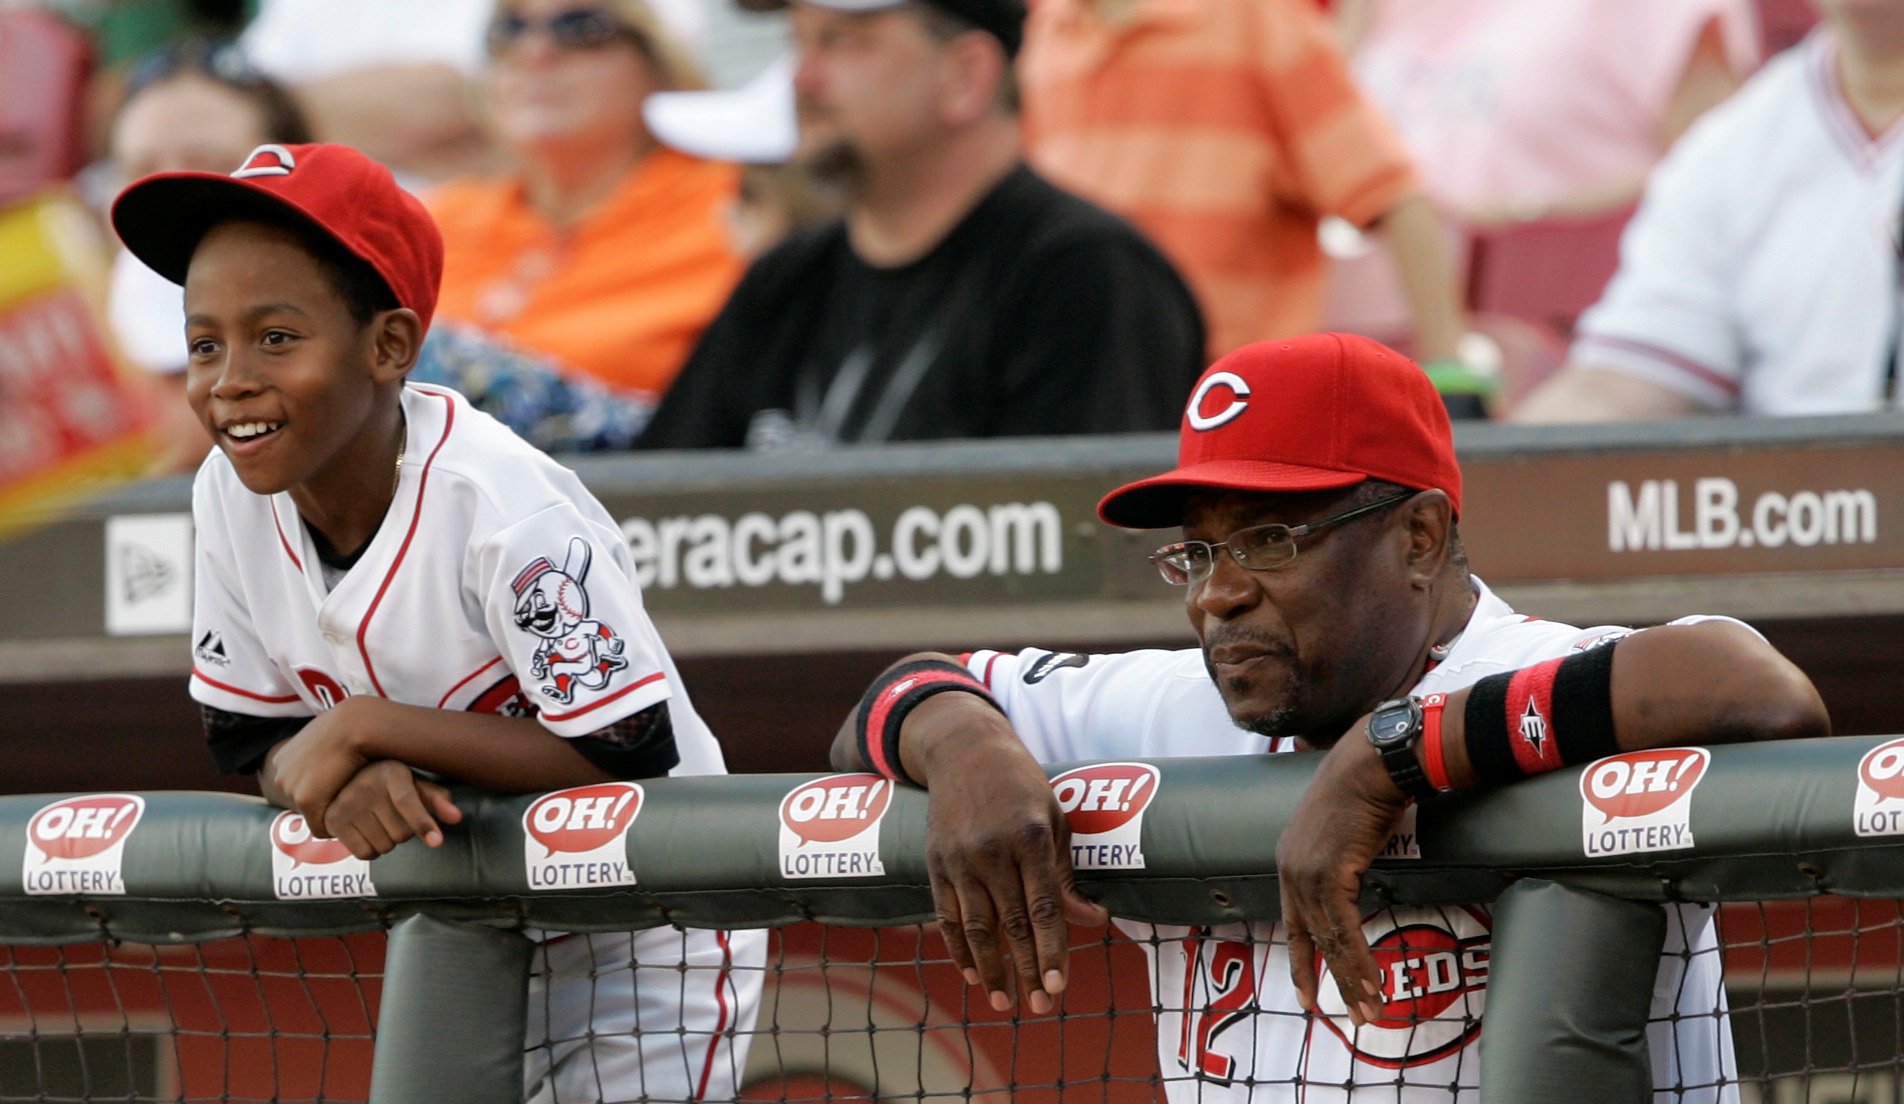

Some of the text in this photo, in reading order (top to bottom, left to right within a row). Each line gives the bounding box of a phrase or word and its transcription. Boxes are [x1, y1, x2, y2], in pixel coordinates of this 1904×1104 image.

[1186, 371, 1250, 432] C
[1607, 476, 1877, 550] MLB.com
[621, 501, 1061, 603] eracap.com
[1591, 753, 1699, 799] OH!
[1868, 746, 1904, 780] O
[533, 790, 634, 834] OH!
[789, 779, 885, 822] OH!
[1057, 773, 1151, 814] OH!
[36, 802, 135, 839] OH!
[1588, 822, 1687, 854] LOTTERY
[1859, 810, 1904, 833] LOT
[532, 861, 625, 886] LOTTERY
[785, 852, 876, 876] LOTTERY
[1071, 844, 1138, 866] TTERY
[27, 871, 118, 891] LOTTERY
[278, 873, 367, 897] LOTTERY
[1379, 942, 1490, 1004] EDS
[1178, 926, 1254, 1088] 12
